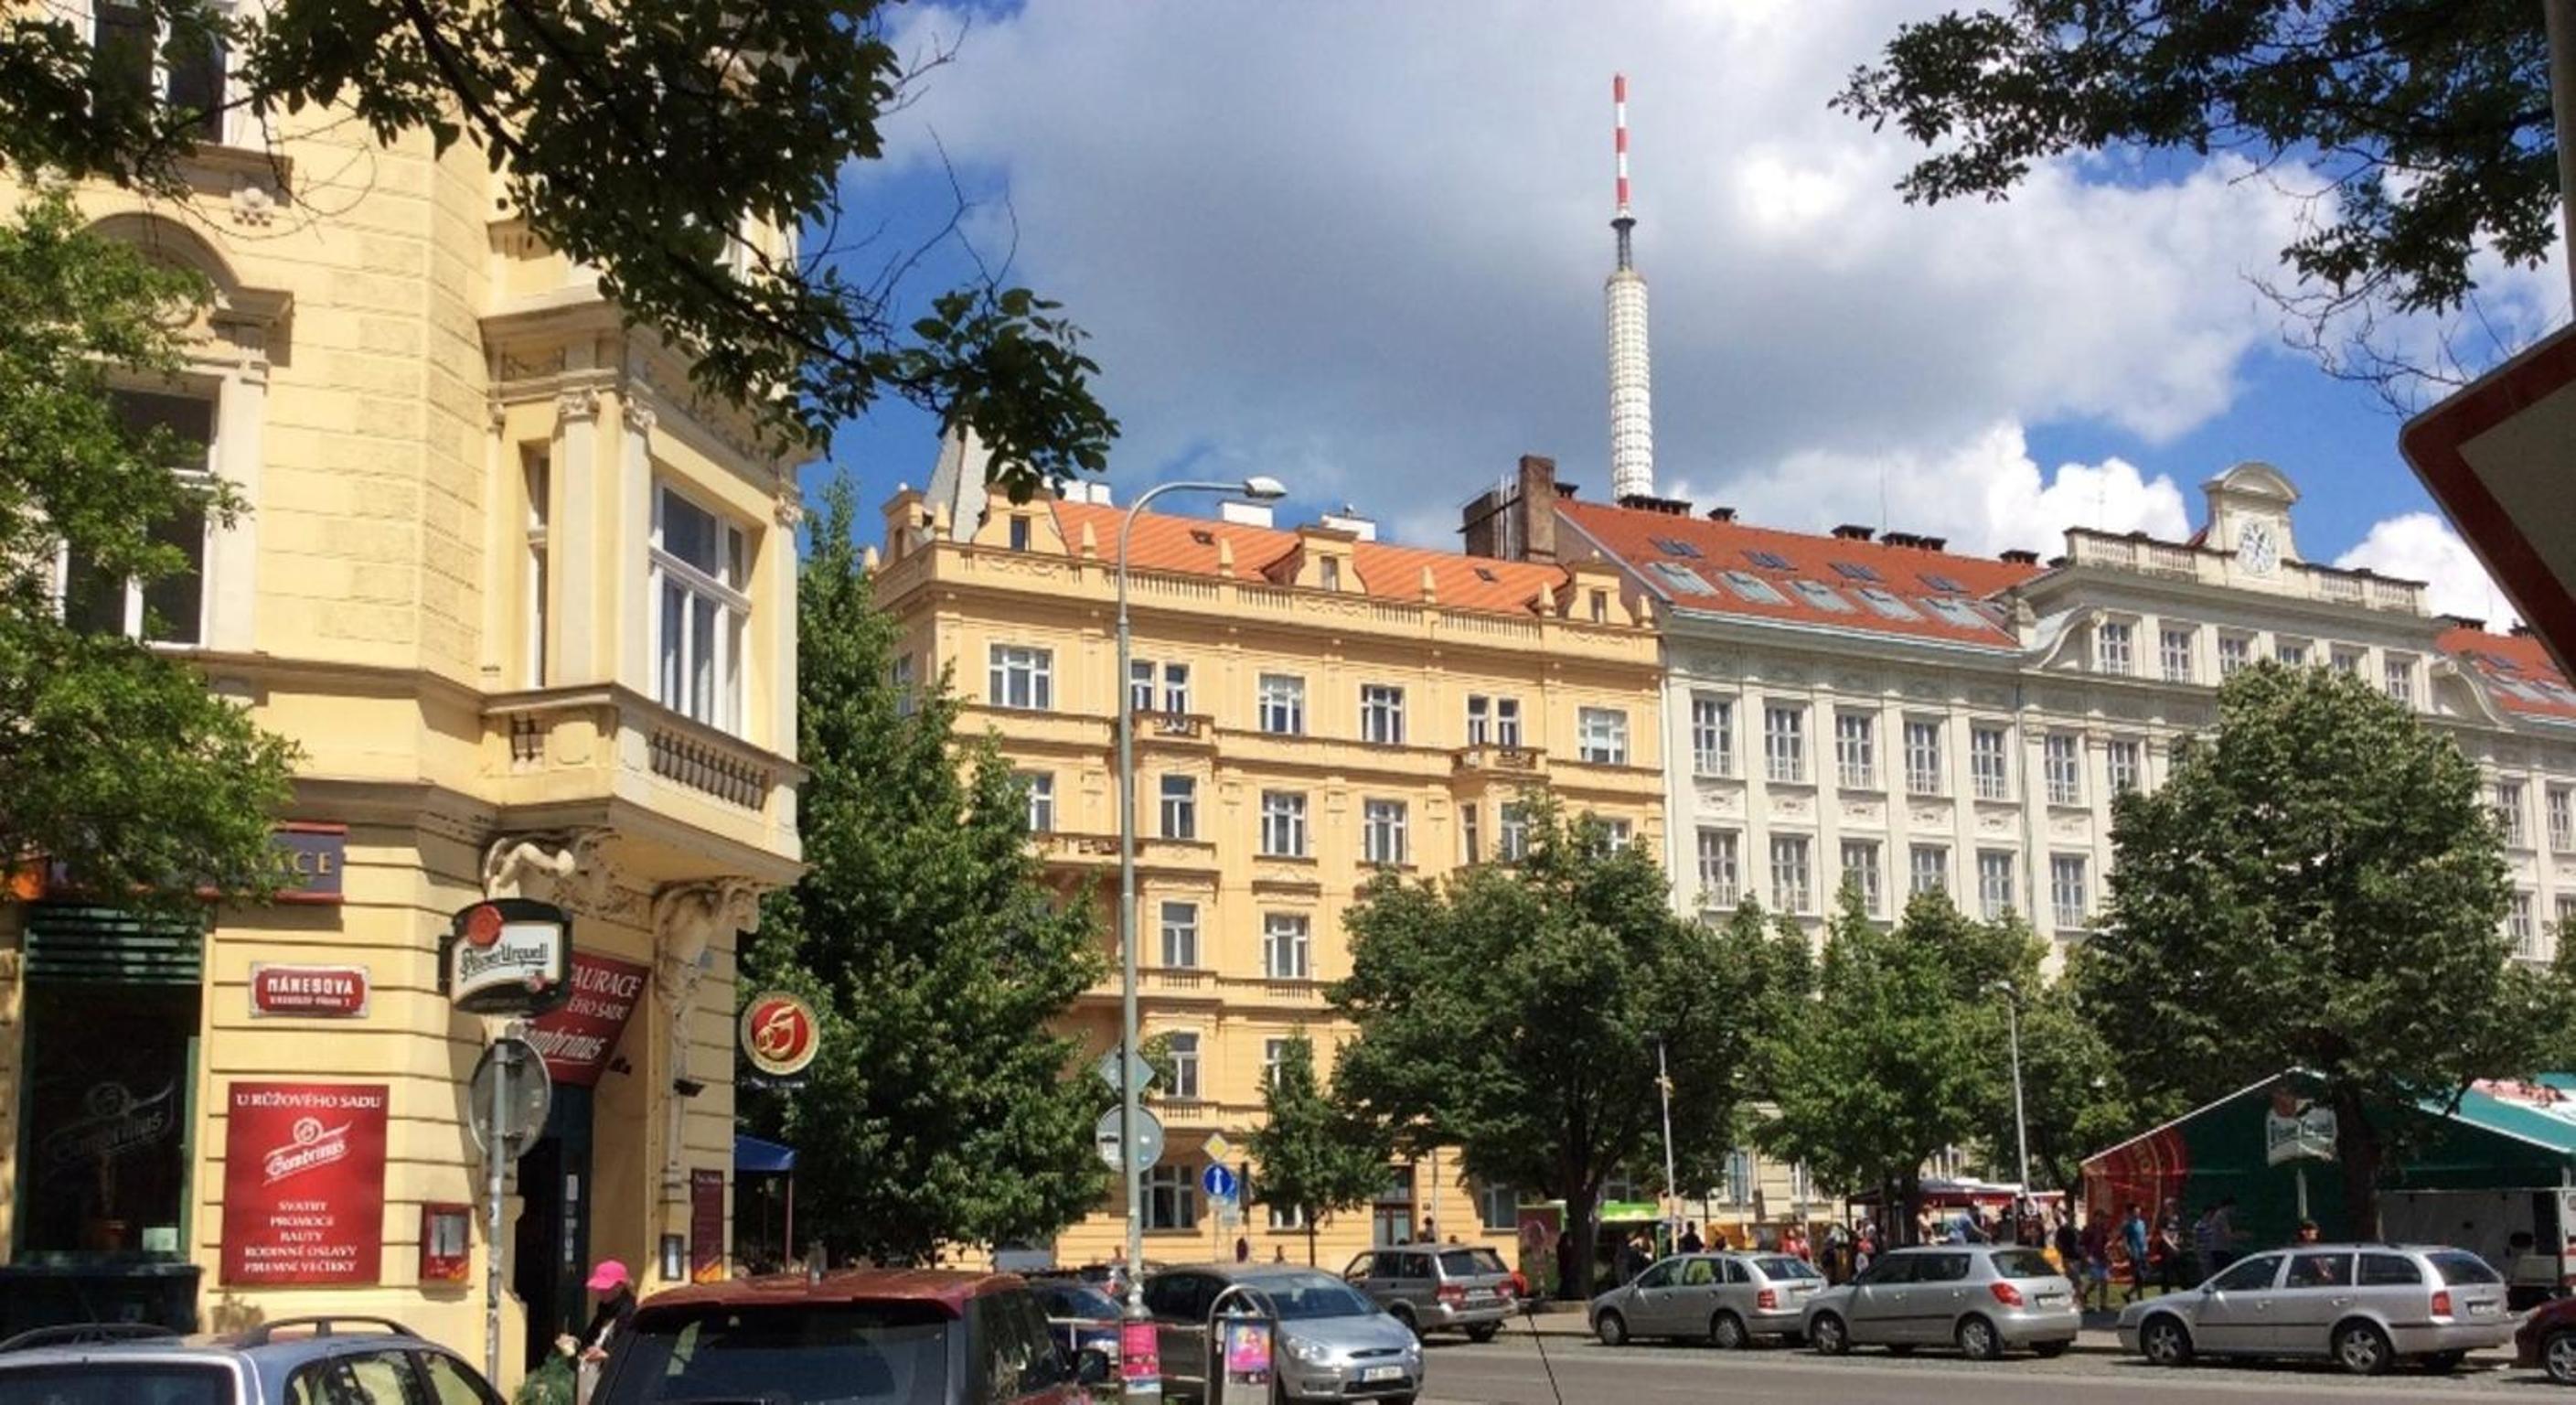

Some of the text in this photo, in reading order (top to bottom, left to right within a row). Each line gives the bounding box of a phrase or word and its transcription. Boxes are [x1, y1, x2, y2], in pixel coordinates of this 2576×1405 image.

[500, 943, 549, 966] Urquell
[267, 976, 355, 995] MÁNESOVA
[236, 1091, 381, 1109] U RŮŽOVÉHO SADU
[270, 1215, 335, 1228] PROMOCE
[306, 1245, 358, 1257] OSLAVY
